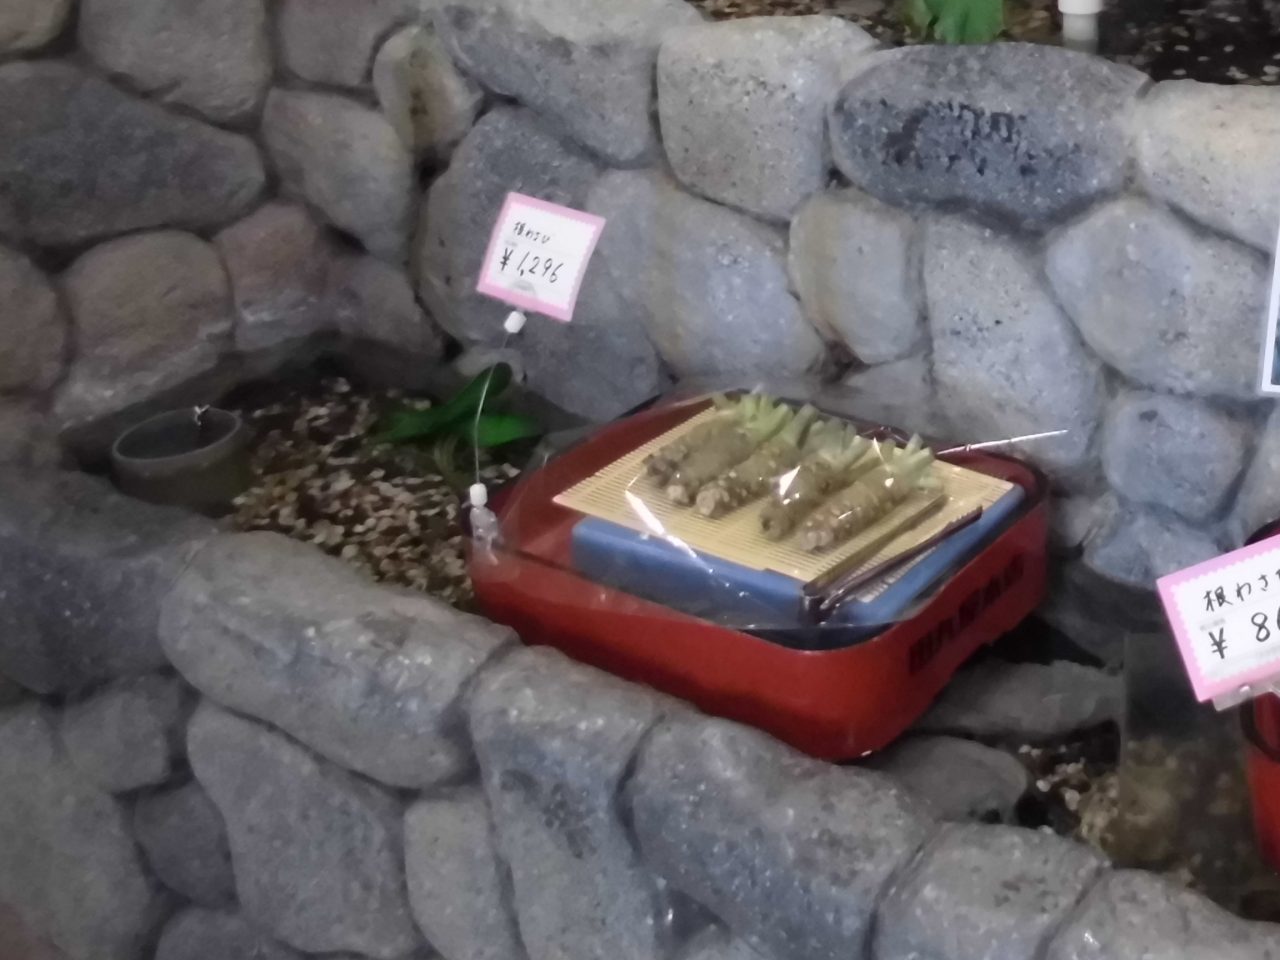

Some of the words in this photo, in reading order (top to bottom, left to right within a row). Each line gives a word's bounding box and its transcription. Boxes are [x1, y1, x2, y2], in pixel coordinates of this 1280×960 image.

[499, 246, 514, 272] ¥
[516, 251, 564, 284] 1,296
[1208, 626, 1229, 660] ¥
